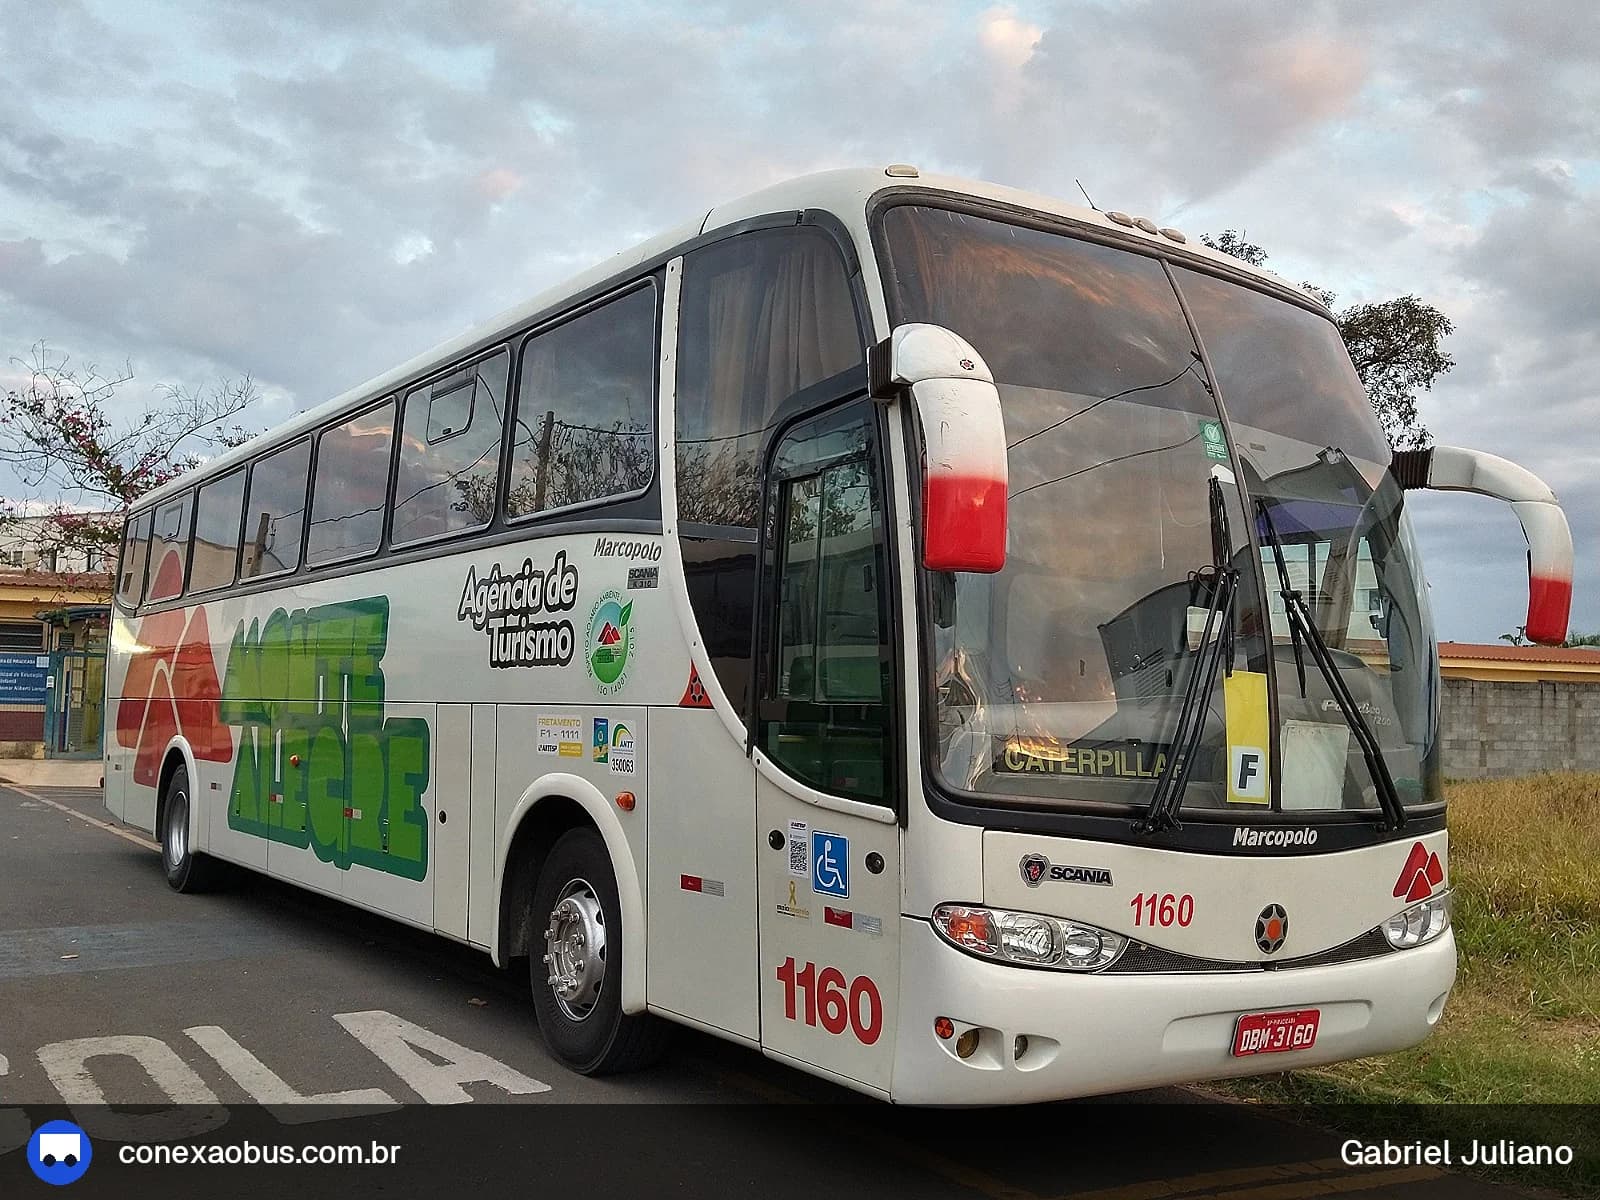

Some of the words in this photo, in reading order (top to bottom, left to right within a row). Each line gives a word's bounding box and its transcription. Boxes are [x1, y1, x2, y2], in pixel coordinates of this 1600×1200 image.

[593, 537, 662, 561] Marcopolo
[629, 567, 658, 578] SCANIA
[459, 560, 544, 629] Agência
[546, 551, 578, 611] de
[487, 614, 575, 668] Turismo
[1322, 699, 1382, 715] Padiso
[538, 718, 581, 727] FRETAMENTO
[619, 740, 634, 749] ANTT
[611, 758, 634, 773] 350063
[1238, 753, 1260, 789] F
[1232, 827, 1318, 847] Marcopolo
[1050, 866, 1112, 884] SCANIA
[1130, 892, 1194, 927] 1160
[776, 956, 883, 1045] 1160
[0, 1010, 553, 1155] OLA
